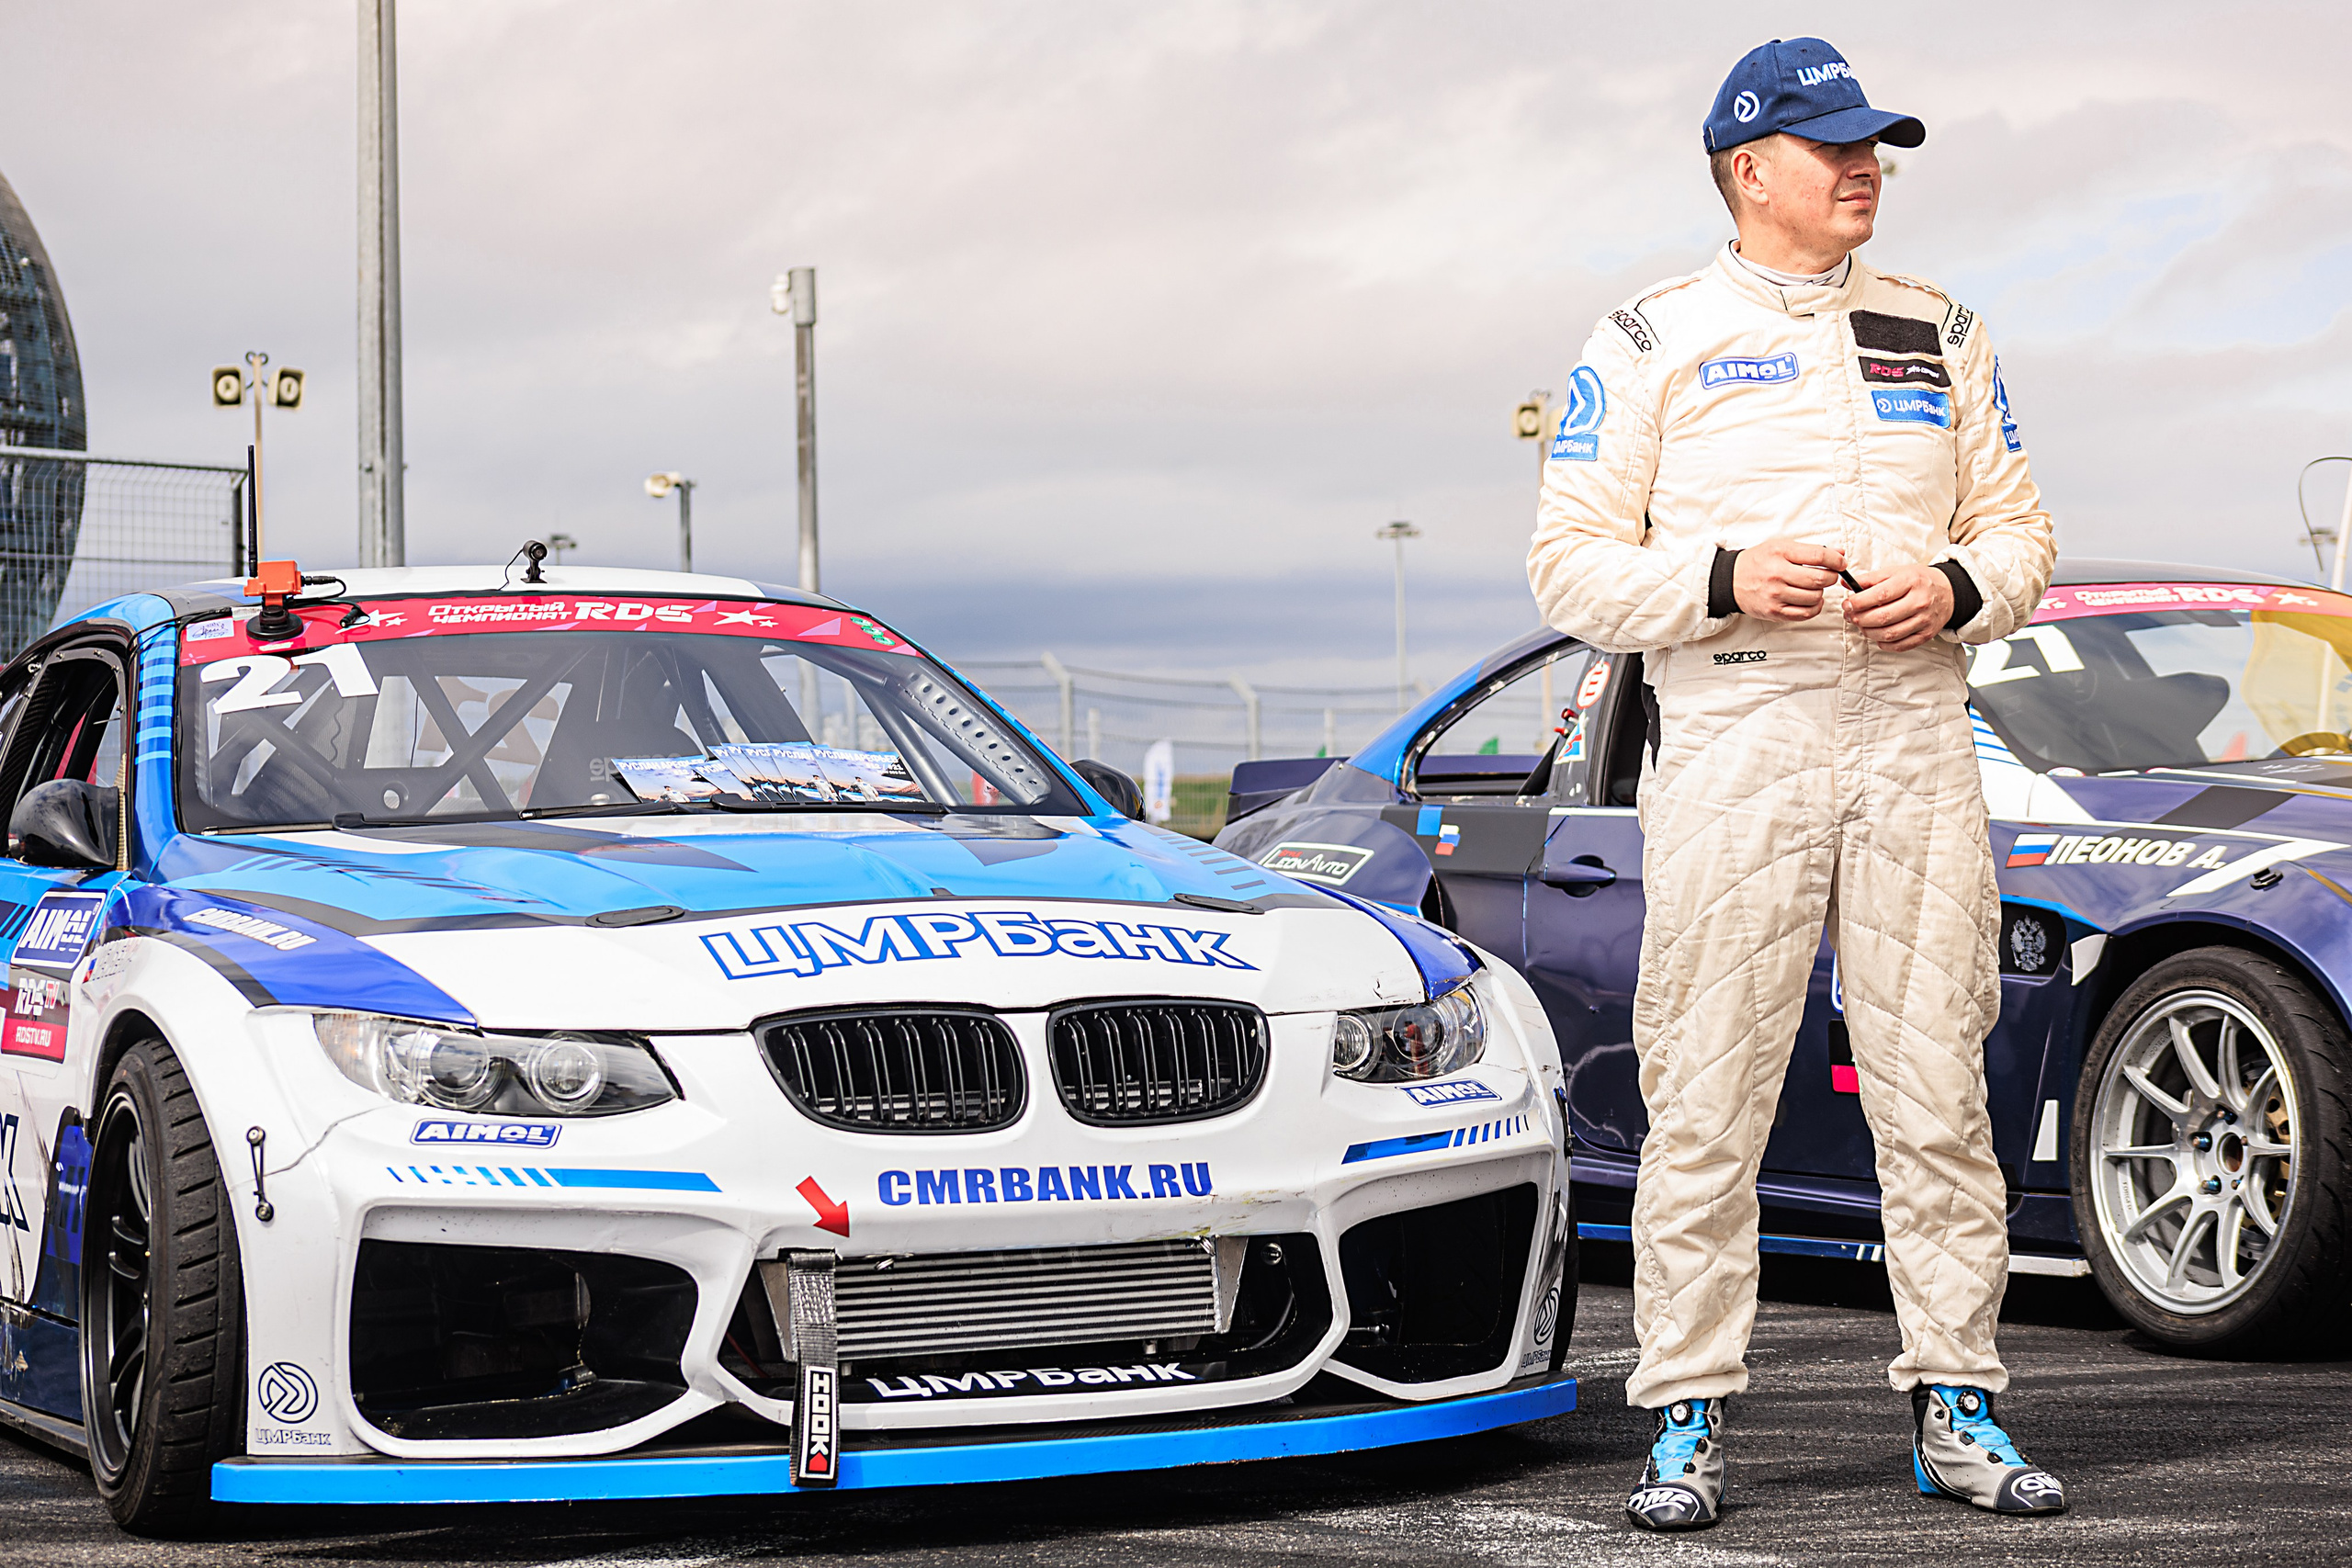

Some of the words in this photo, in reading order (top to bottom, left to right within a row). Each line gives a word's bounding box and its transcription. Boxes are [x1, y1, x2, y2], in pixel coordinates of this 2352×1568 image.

[1608, 310, 1652, 352] sparco
[1706, 360, 1794, 384] AIMOL
[1893, 399, 1947, 417] ЦМРБанк
[574, 602, 695, 624] RDS
[1713, 649, 1767, 665] sparco
[200, 642, 379, 715] 21
[2044, 835, 2197, 866] ЛЕОНОВ
[2186, 844, 2228, 869] А.
[19, 908, 92, 952] AIMOL
[699, 911, 1262, 980] ЦМРБанк
[1409, 1082, 1493, 1103] AIMOL
[416, 1123, 549, 1144] AIMOL
[876, 1162, 1214, 1206] CMRBANK.RU
[866, 1361, 1195, 1400] ЦМРБанк
[809, 1372, 831, 1455] HOOK
[255, 1427, 332, 1446] ЦМРБанк
[1628, 1491, 1693, 1511] OMP
